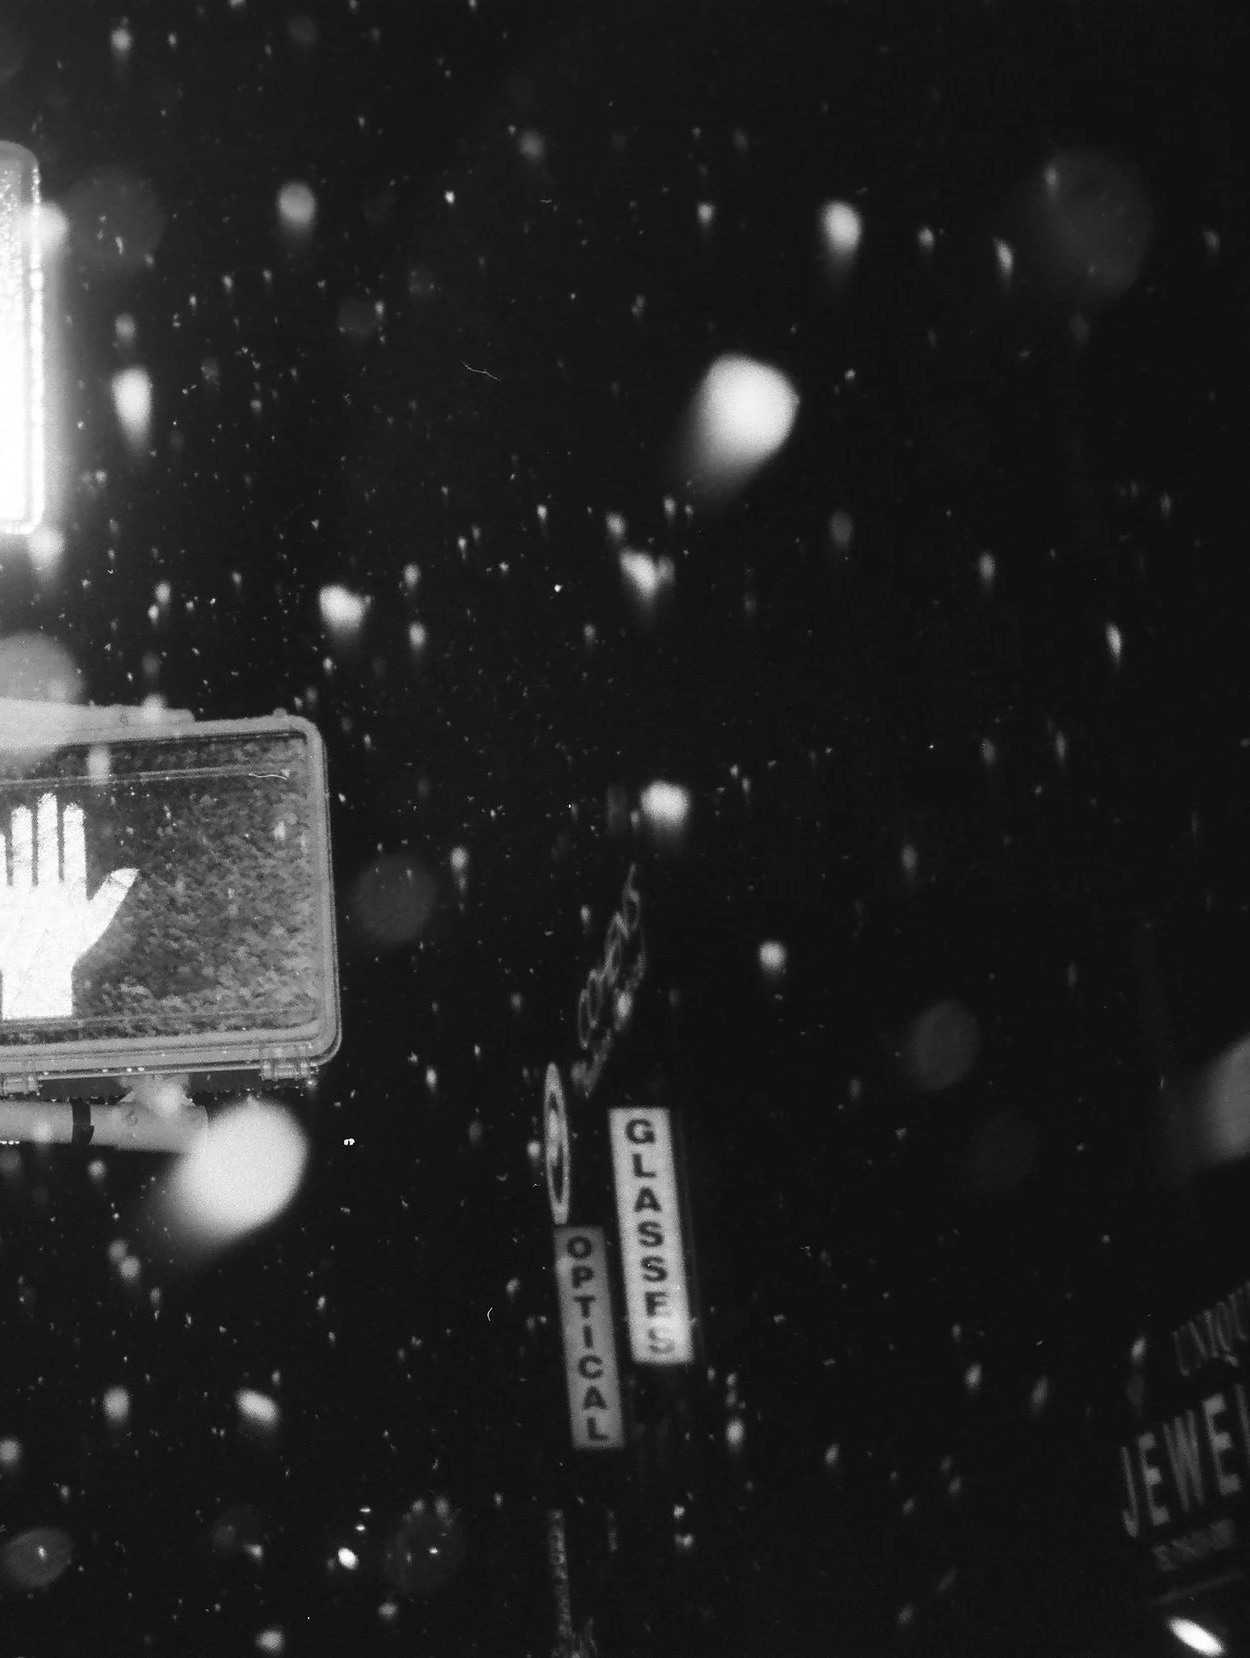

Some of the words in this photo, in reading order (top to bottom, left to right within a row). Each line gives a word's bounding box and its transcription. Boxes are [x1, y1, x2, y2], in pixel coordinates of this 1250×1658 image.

[565, 1235, 608, 1442] OPTICAL
[623, 1118, 676, 1354] GLASSES
[1168, 1280, 1250, 1377] UNIQU
